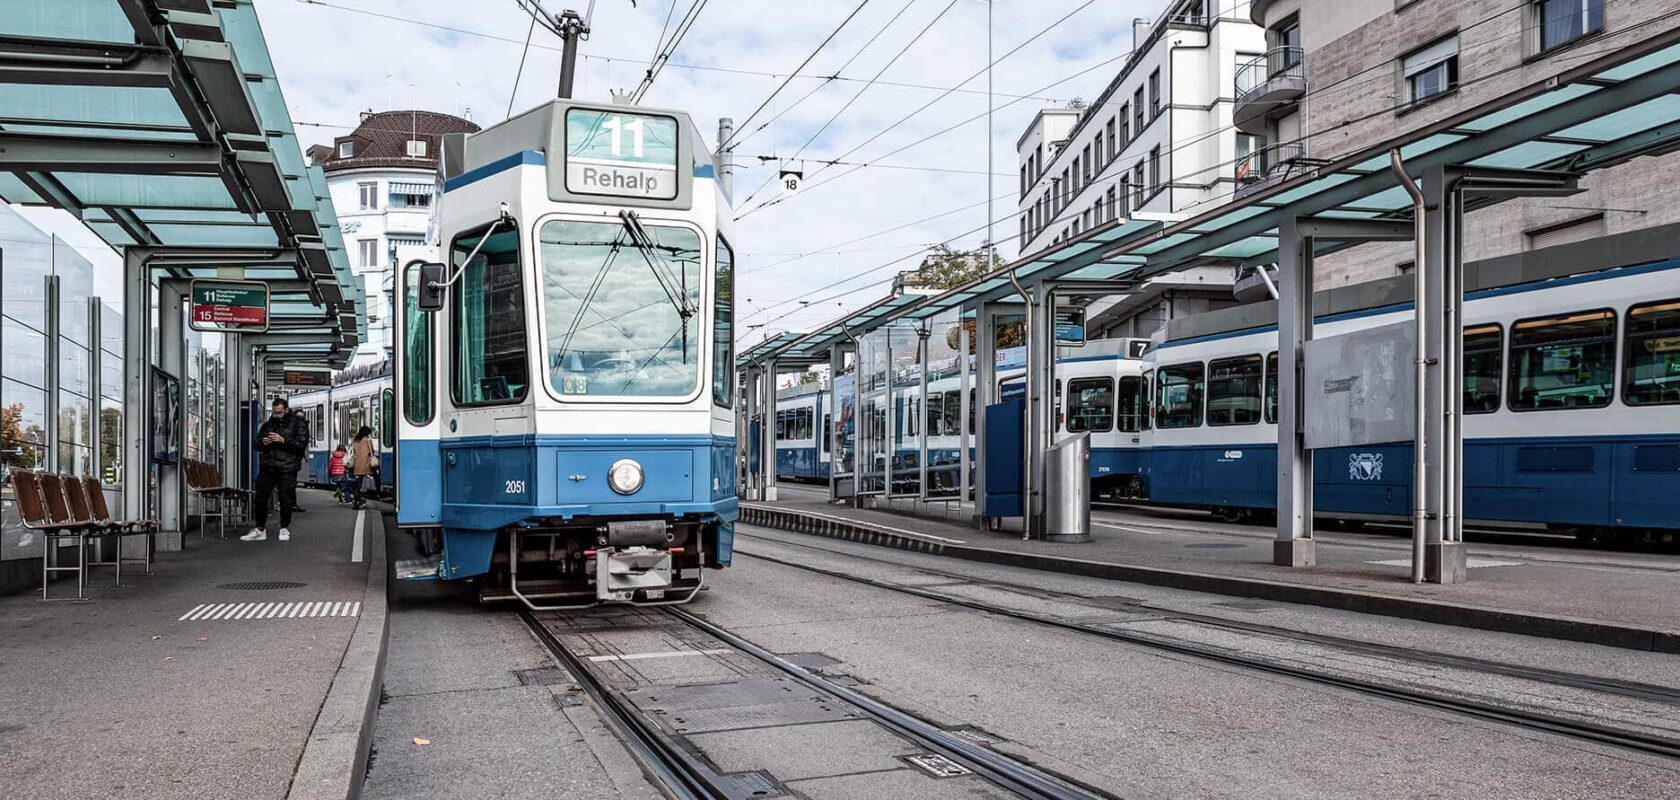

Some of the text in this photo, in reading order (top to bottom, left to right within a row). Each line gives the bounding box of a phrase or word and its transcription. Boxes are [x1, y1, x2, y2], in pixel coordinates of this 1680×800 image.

[602, 116, 643, 158] 11
[583, 167, 657, 193] Rehalp
[785, 179, 797, 190] 18
[203, 291, 215, 302] 11
[200, 310, 212, 320] 15
[1137, 343, 1147, 357] 7
[506, 480, 525, 493] 2051
